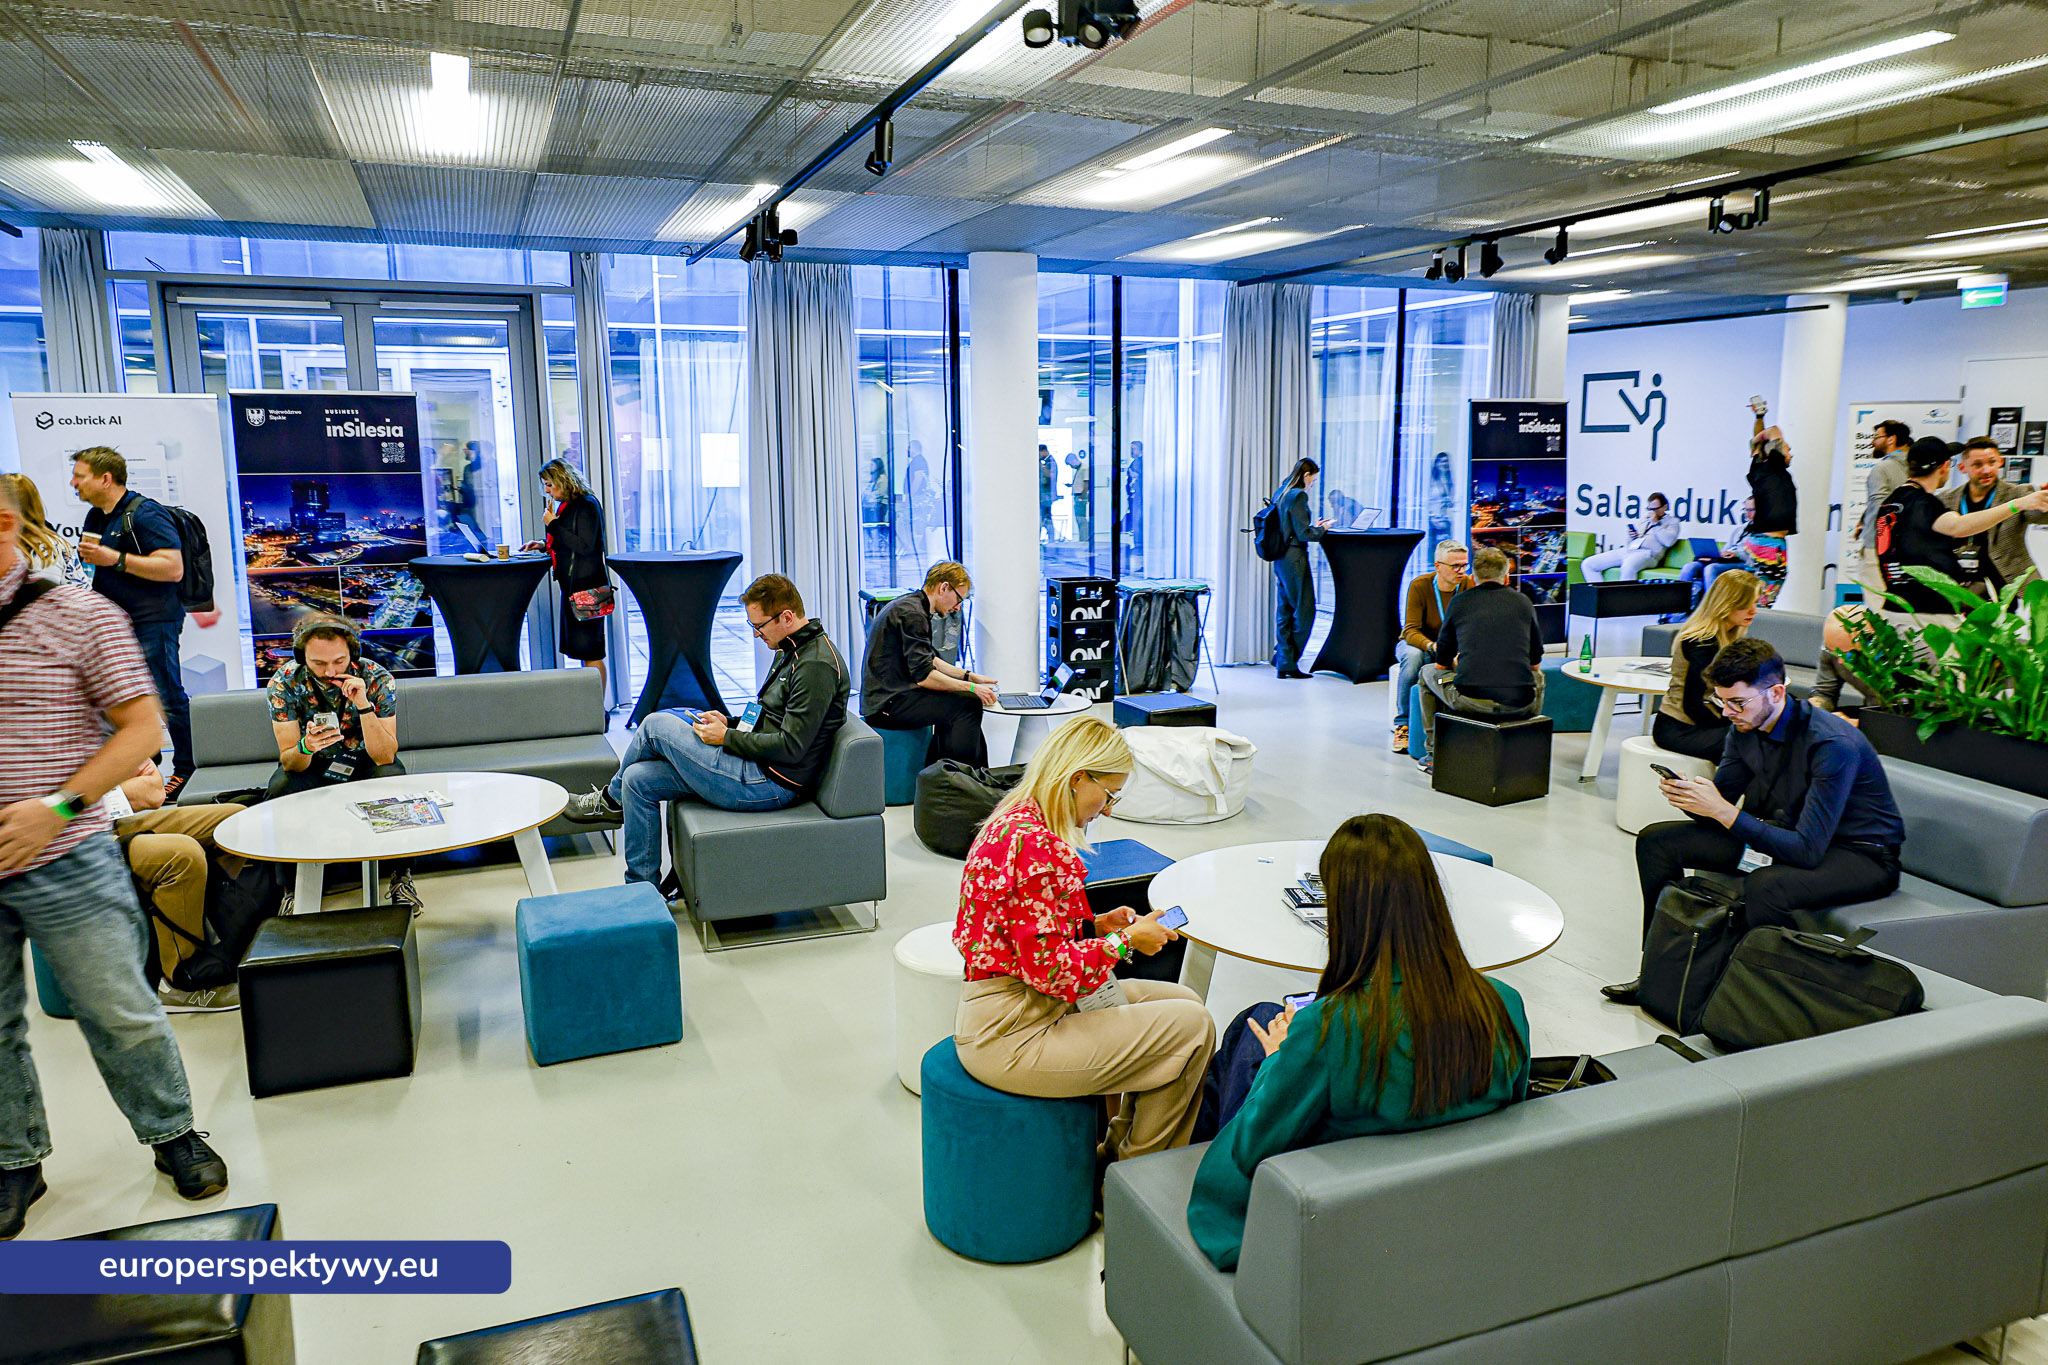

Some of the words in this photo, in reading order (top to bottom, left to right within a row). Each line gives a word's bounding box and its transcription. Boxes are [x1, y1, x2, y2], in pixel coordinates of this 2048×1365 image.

[58, 415, 106, 425] co.brick
[109, 415, 122, 425] AI
[325, 418, 404, 437] inSilesia
[1576, 484, 1640, 519] Sala
